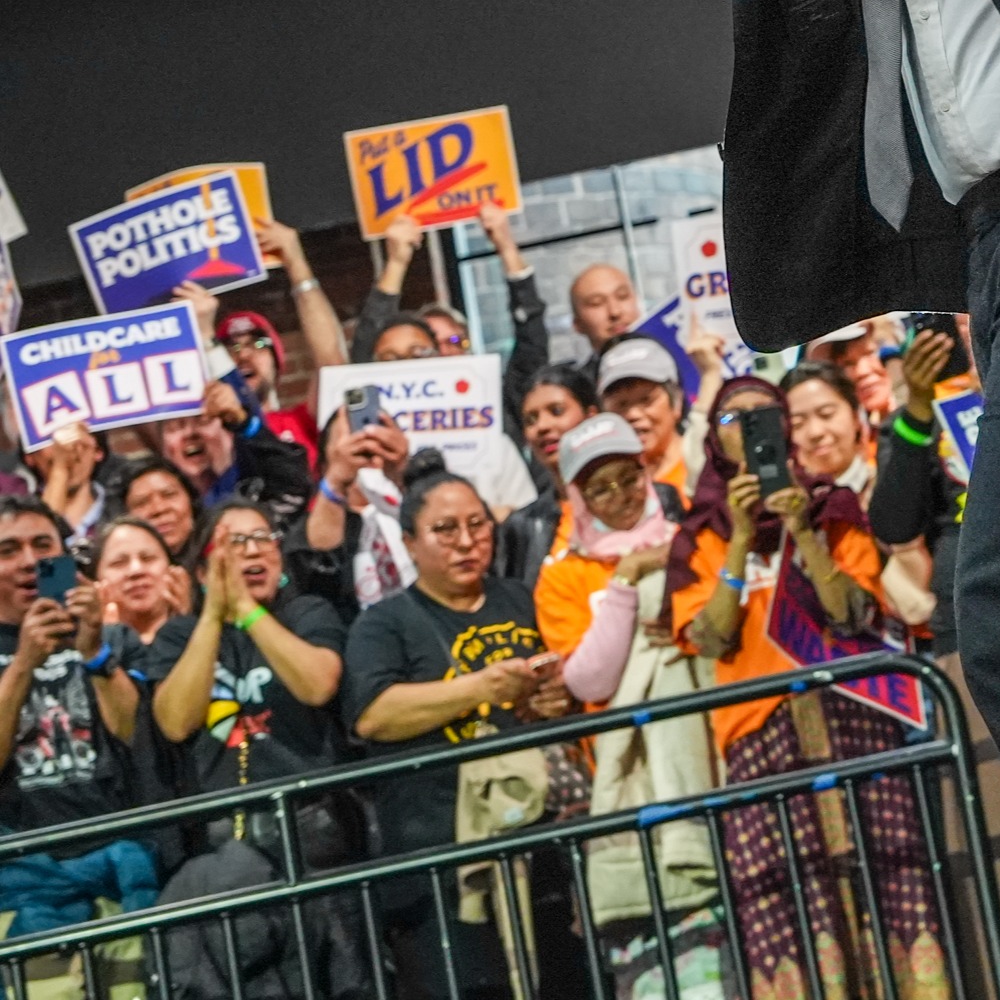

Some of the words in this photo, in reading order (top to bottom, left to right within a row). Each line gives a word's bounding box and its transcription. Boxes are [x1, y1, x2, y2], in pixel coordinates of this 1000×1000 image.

[368, 122, 473, 218] LID
[437, 192, 471, 211] ON
[475, 184, 498, 203] IT
[85, 187, 235, 259] POTHOLE
[96, 214, 242, 288] POLITICS
[19, 316, 182, 366] CHILDCARE
[44, 360, 193, 424] ALL
[378, 381, 445, 400] N.Y.C.
[392, 406, 494, 432] CERIES
[778, 600, 912, 714] WAE
